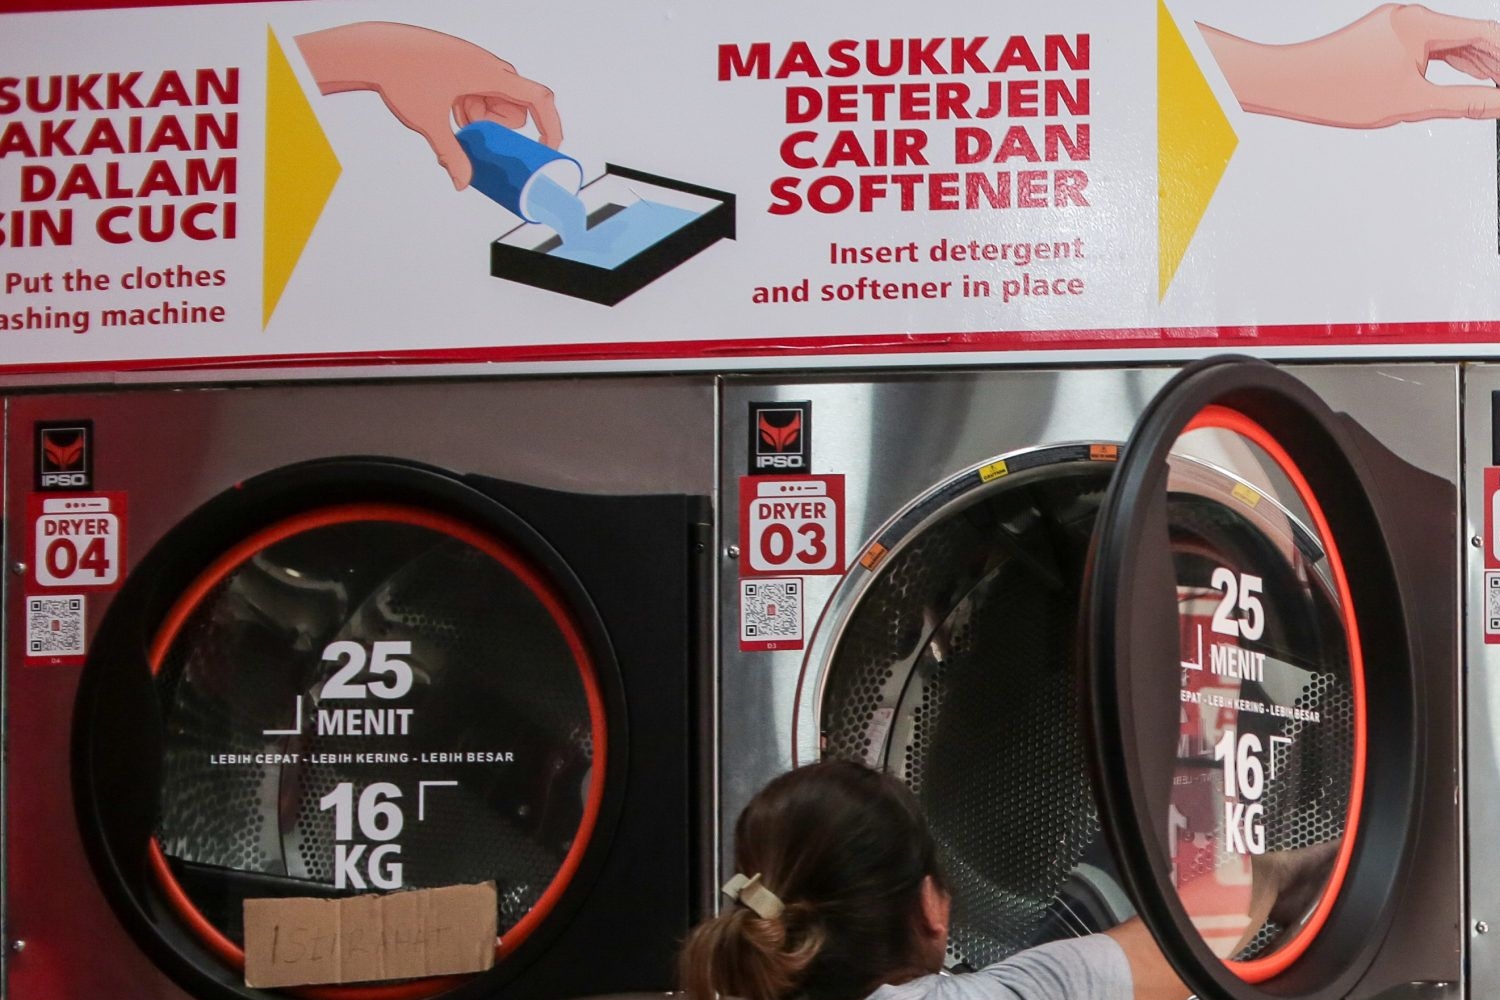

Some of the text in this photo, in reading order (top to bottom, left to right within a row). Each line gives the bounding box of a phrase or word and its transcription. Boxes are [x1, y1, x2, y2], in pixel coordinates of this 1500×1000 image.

[718, 34, 1090, 81] MASUKKAN
[786, 78, 1090, 124] DETERJEN
[0, 112, 238, 158] AKAIAN
[780, 124, 1090, 169] CAIR DAN
[21, 157, 237, 202] DALAM
[767, 169, 1090, 215] SOFTENER
[96, 202, 236, 244] CUCI
[831, 236, 1085, 266] Insert detergent
[6, 265, 226, 294] Put the clothes
[752, 272, 1085, 304] and softener in place
[102, 301, 225, 326] machine
[42, 474, 86, 487] IPSO
[757, 456, 802, 468] IPSO
[45, 519, 109, 536] DRYER
[759, 502, 826, 520] DRYER
[46, 538, 109, 579] 04
[760, 523, 826, 565] 03
[1211, 567, 1265, 640] 25
[320, 641, 413, 699] 25
[1210, 644, 1266, 682] MENIT
[318, 709, 413, 735] MENIT
[211, 752, 514, 764] LEBIH CEPAT LEBIH KERING LEBIH BESAR
[1214, 730, 1263, 800] 16
[320, 782, 404, 840] 16
[1225, 802, 1265, 855] KG
[334, 844, 403, 889] KG
